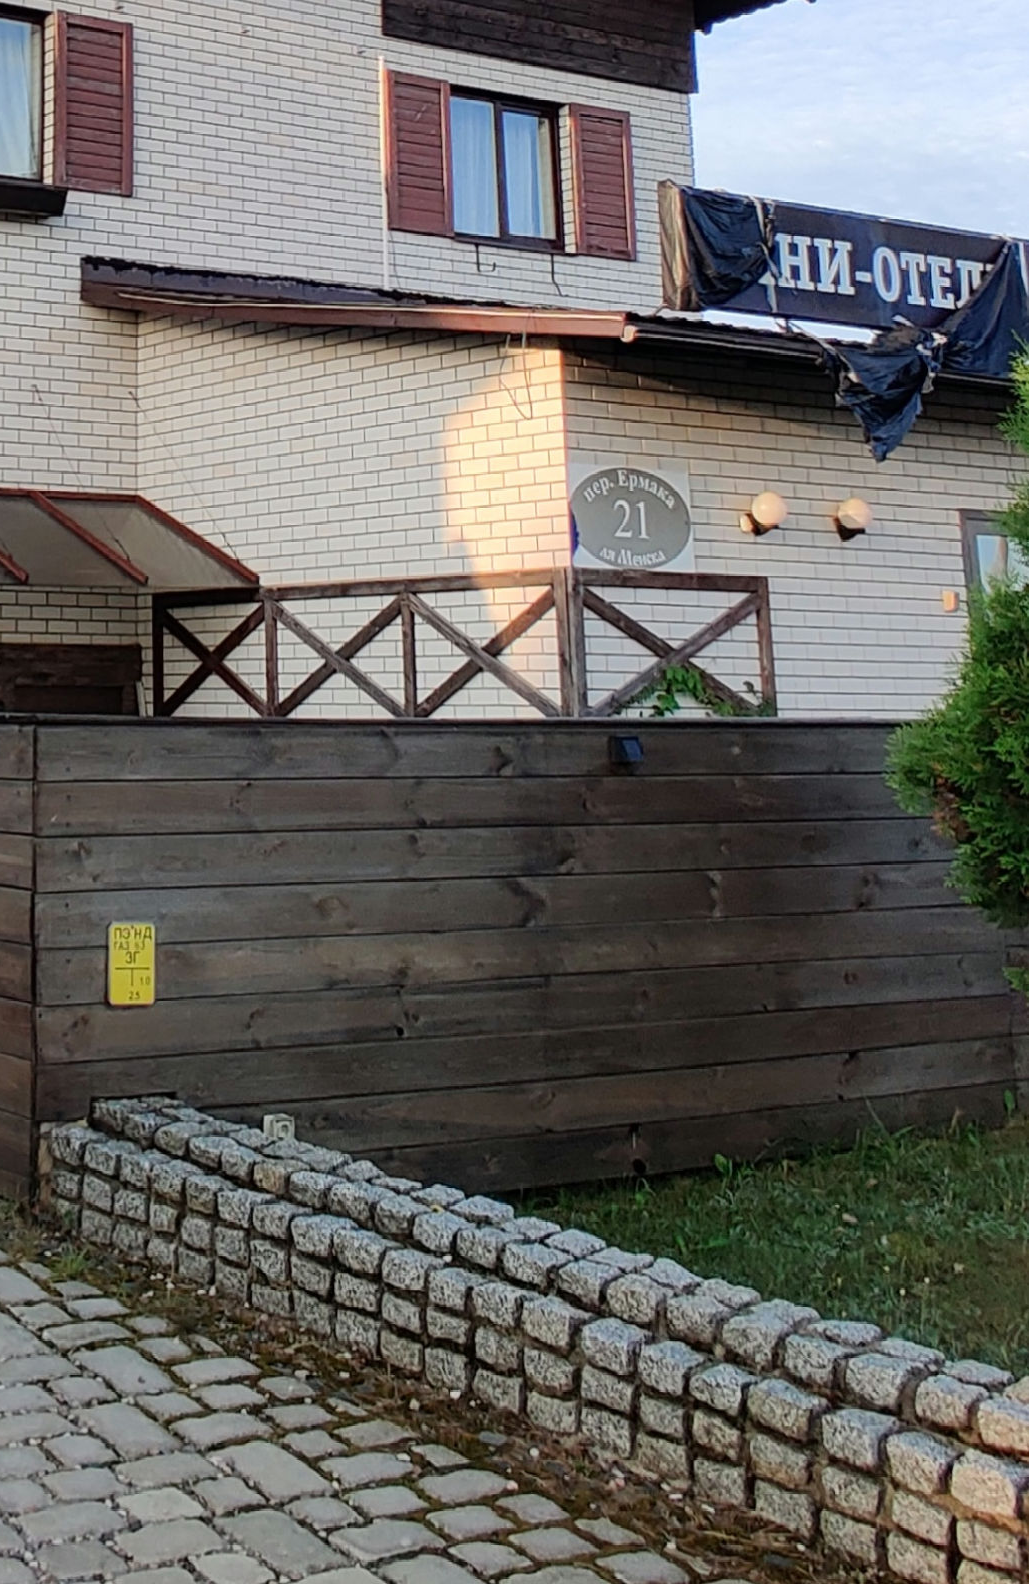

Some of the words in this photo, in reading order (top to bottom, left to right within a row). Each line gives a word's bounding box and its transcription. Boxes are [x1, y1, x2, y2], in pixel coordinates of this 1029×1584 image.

[759, 233, 993, 310] НИ-ОТЕЛ
[583, 477, 614, 502] пер.
[617, 469, 675, 509] Ермака
[613, 499, 650, 539] 21
